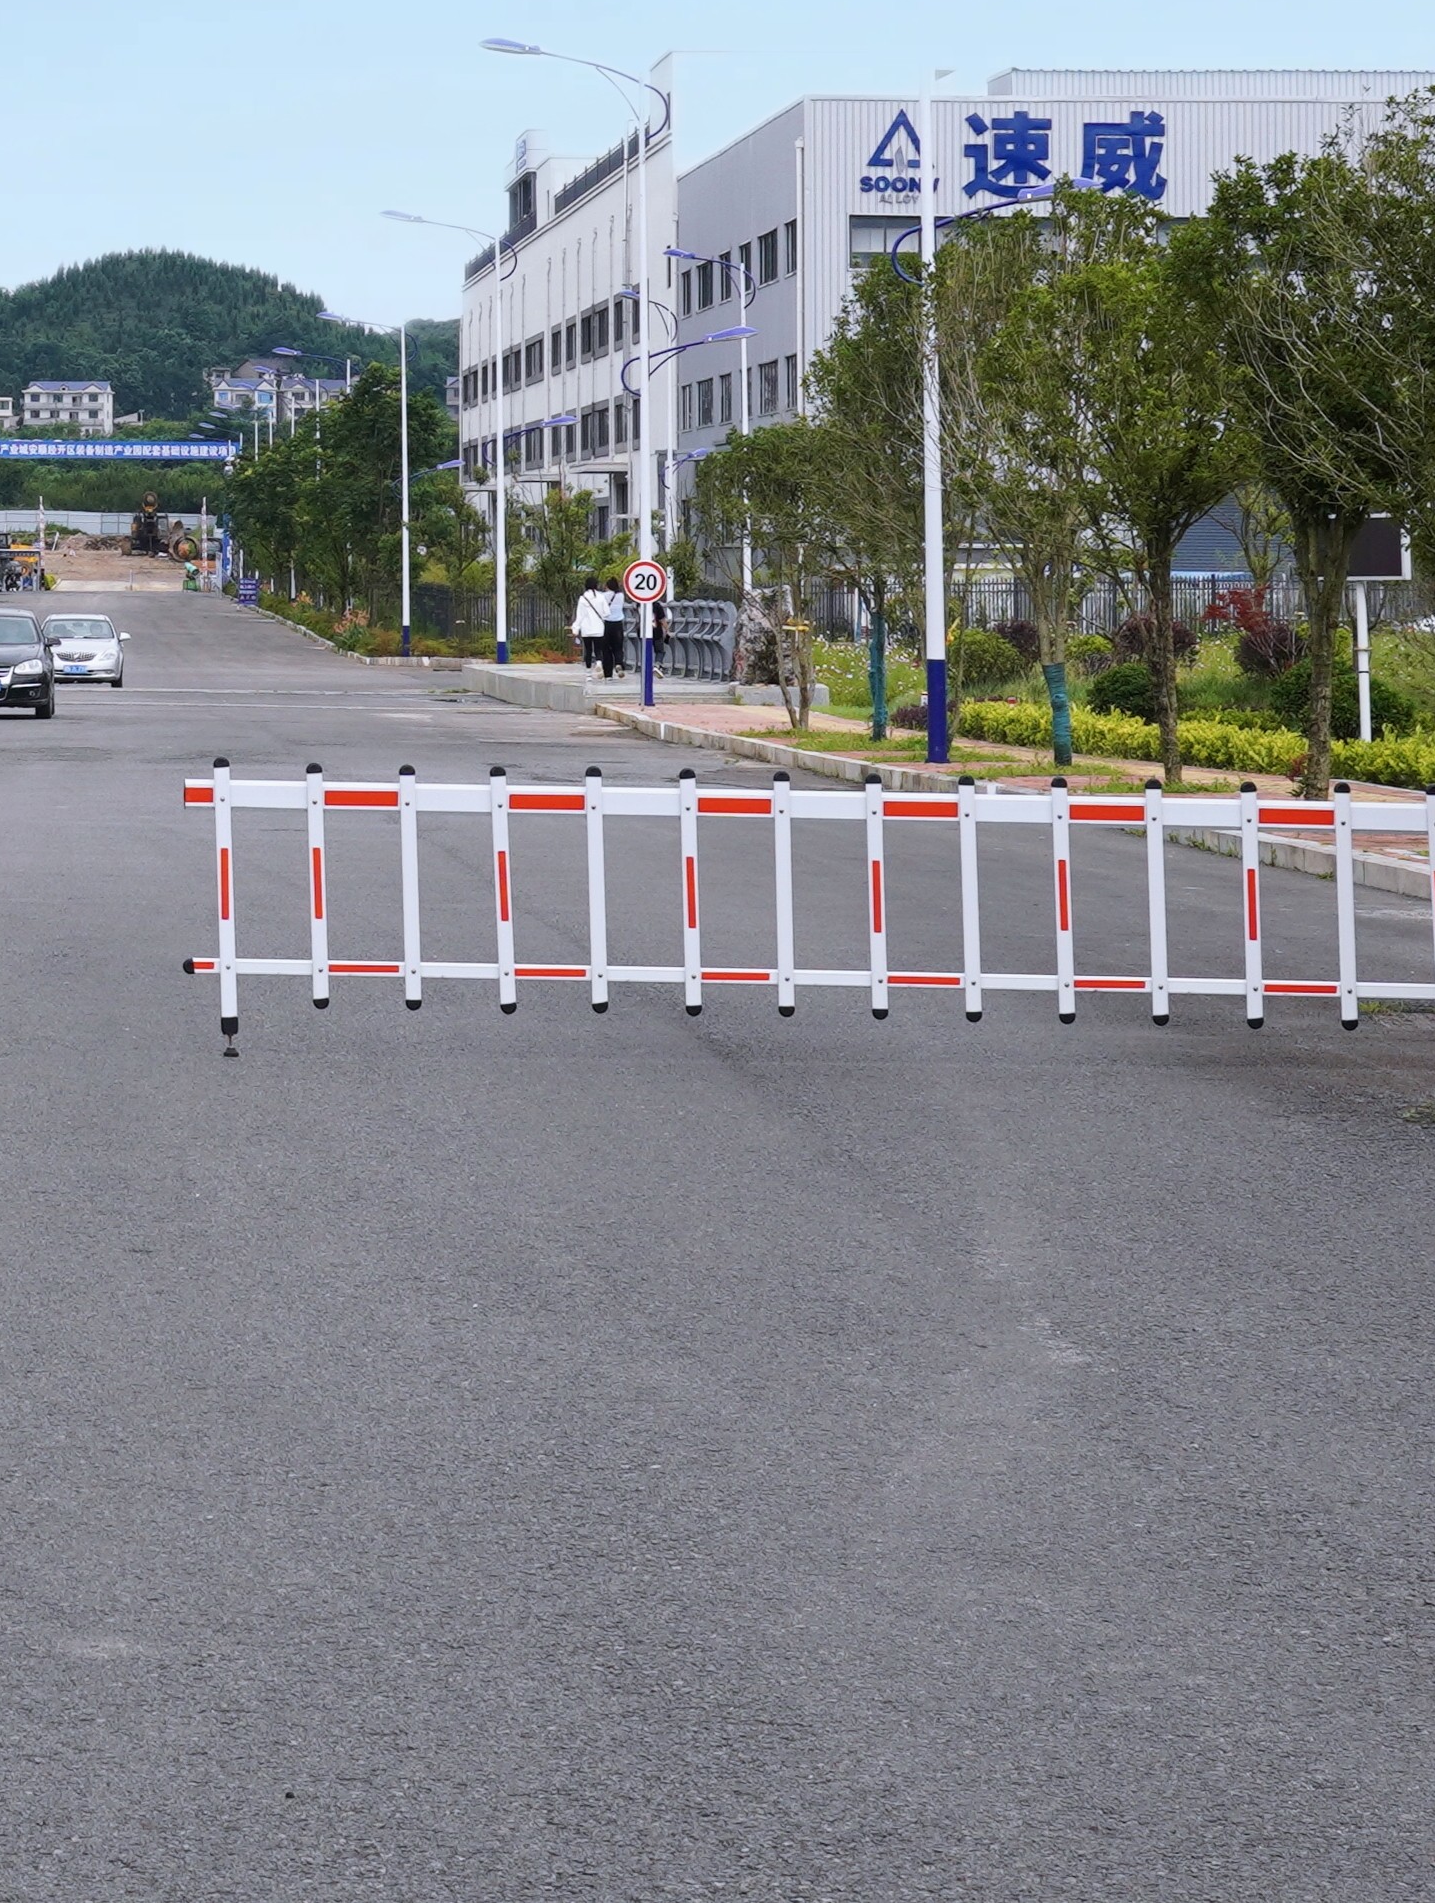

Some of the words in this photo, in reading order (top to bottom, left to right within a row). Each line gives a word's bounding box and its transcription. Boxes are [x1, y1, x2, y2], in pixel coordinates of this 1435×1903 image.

[962, 110, 1169, 201] 速威
[860, 175, 940, 194] SOON
[634, 573, 657, 591] 20
